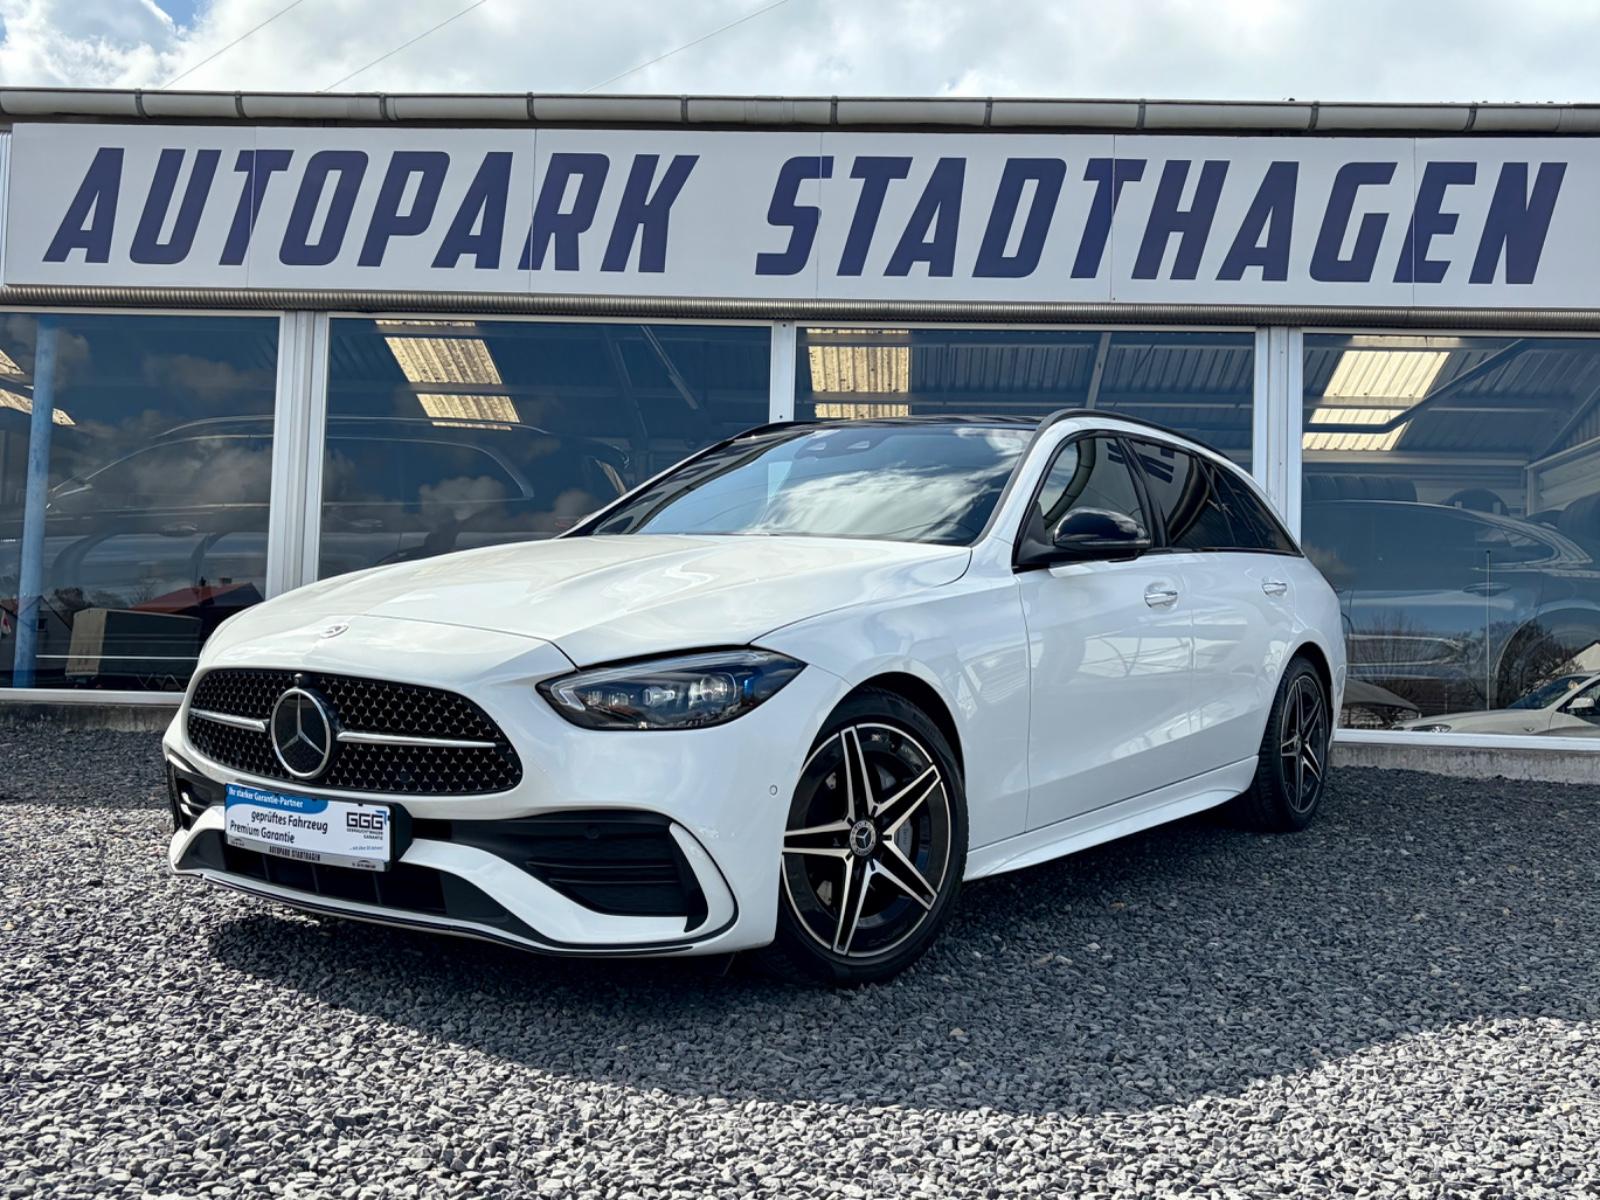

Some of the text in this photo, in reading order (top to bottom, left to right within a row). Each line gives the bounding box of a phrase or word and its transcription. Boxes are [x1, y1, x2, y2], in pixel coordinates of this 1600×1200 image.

[42, 147, 1568, 284] AUTOPARK STADTHAGEN
[236, 789, 253, 800] starker
[230, 820, 260, 837] Premium
[261, 827, 295, 844] Garantie
[251, 810, 287, 826] geprüftes
[288, 815, 328, 835] Fahrzeug
[346, 811, 383, 830] GGG
